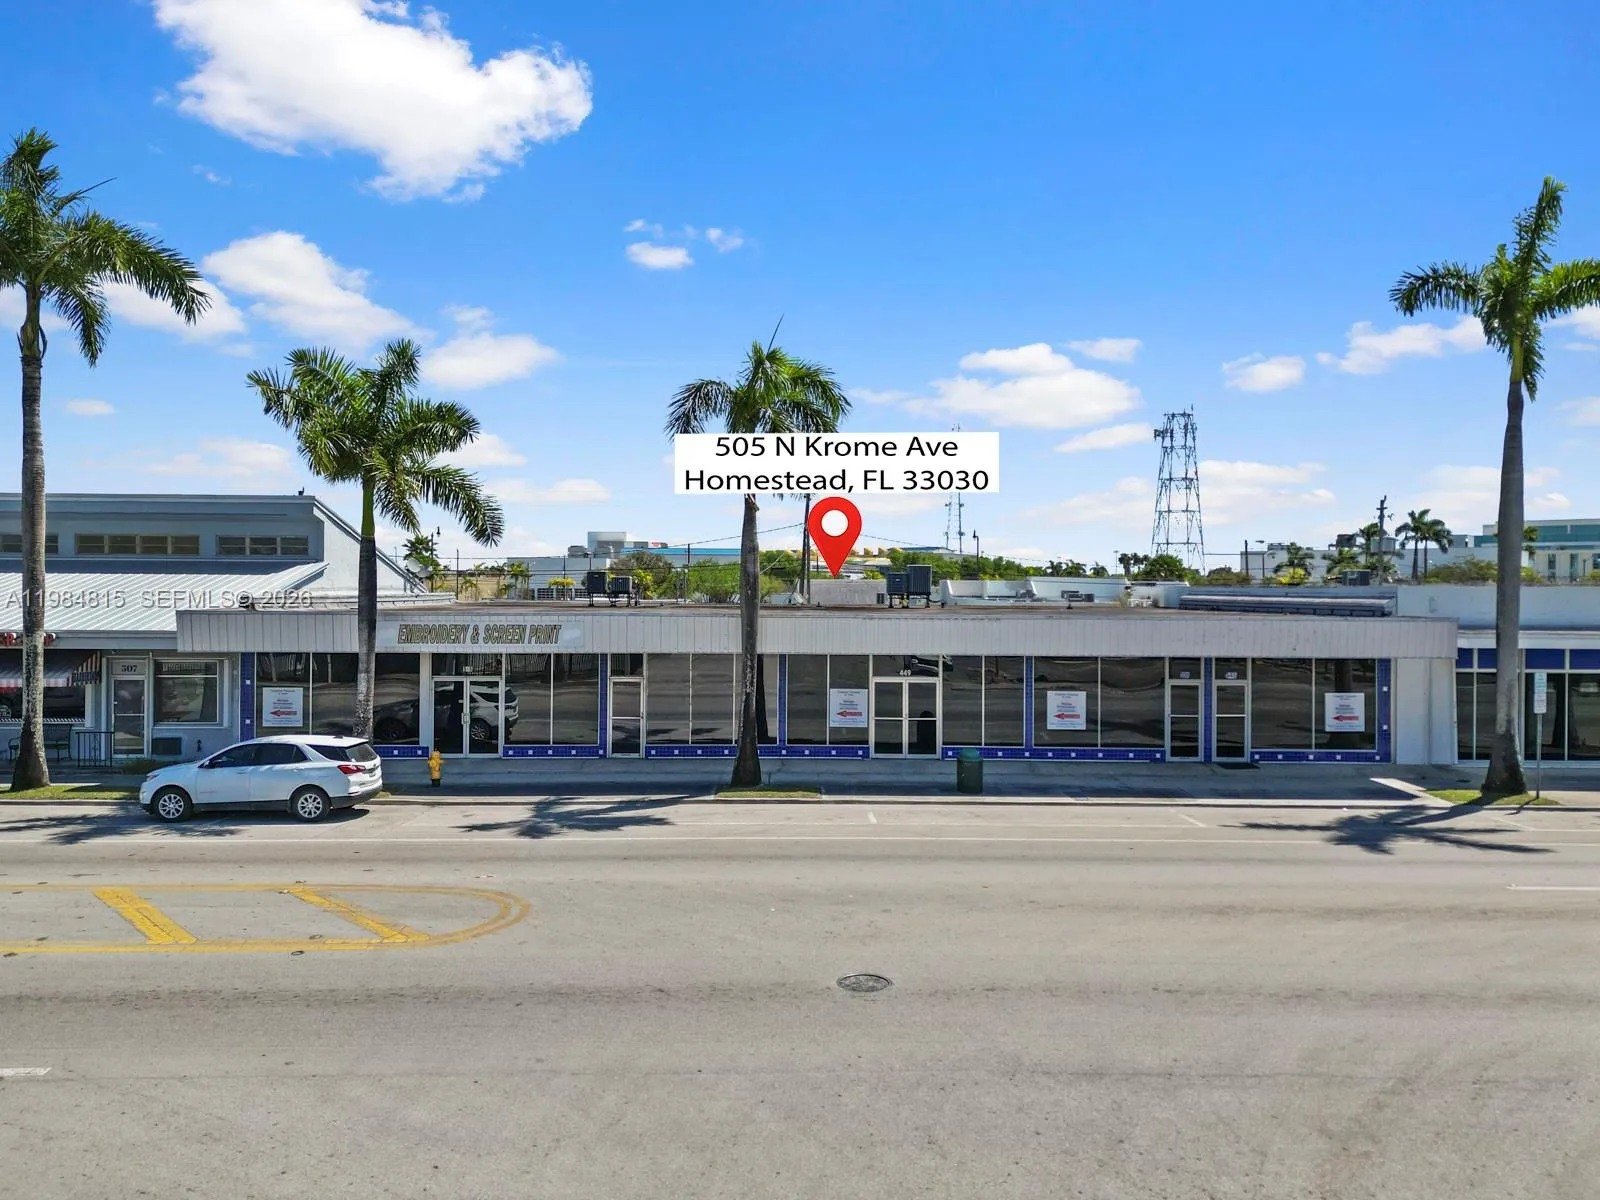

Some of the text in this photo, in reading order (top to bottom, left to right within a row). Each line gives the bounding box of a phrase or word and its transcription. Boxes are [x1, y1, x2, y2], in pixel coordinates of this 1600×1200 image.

[398, 624, 562, 645] EMBROIDERY & SCREEN PRINT
